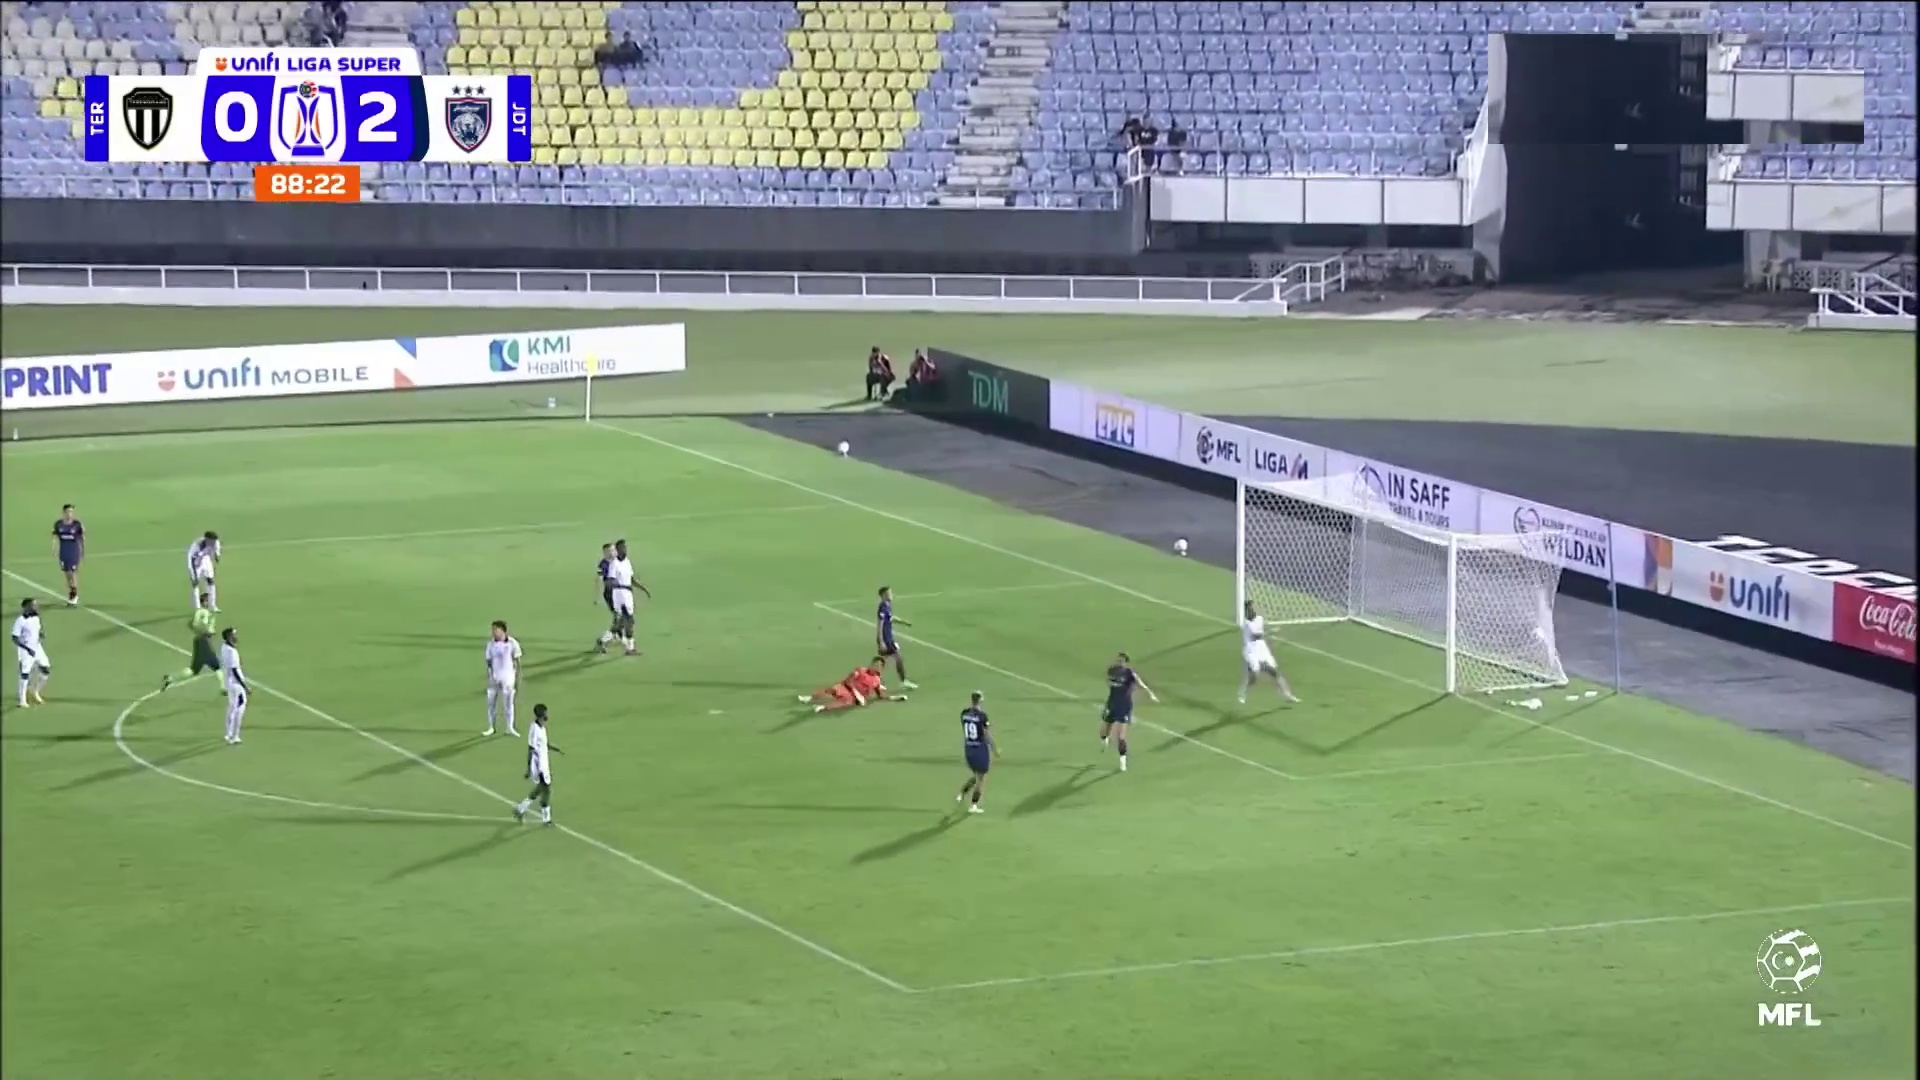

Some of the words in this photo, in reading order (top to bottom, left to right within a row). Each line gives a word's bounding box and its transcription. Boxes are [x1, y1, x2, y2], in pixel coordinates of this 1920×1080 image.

[527, 335, 571, 355] KMI
[3, 363, 112, 398] PRINT
[271, 366, 369, 385] MOBILE
[968, 370, 1009, 415] TDM
[1098, 404, 1135, 447] EPIC
[1216, 439, 1242, 464] MFL
[1255, 447, 1288, 475] LIGA
[1388, 471, 1405, 499] IN
[1410, 478, 1451, 510] SAFF
[964, 722, 978, 740] 19
